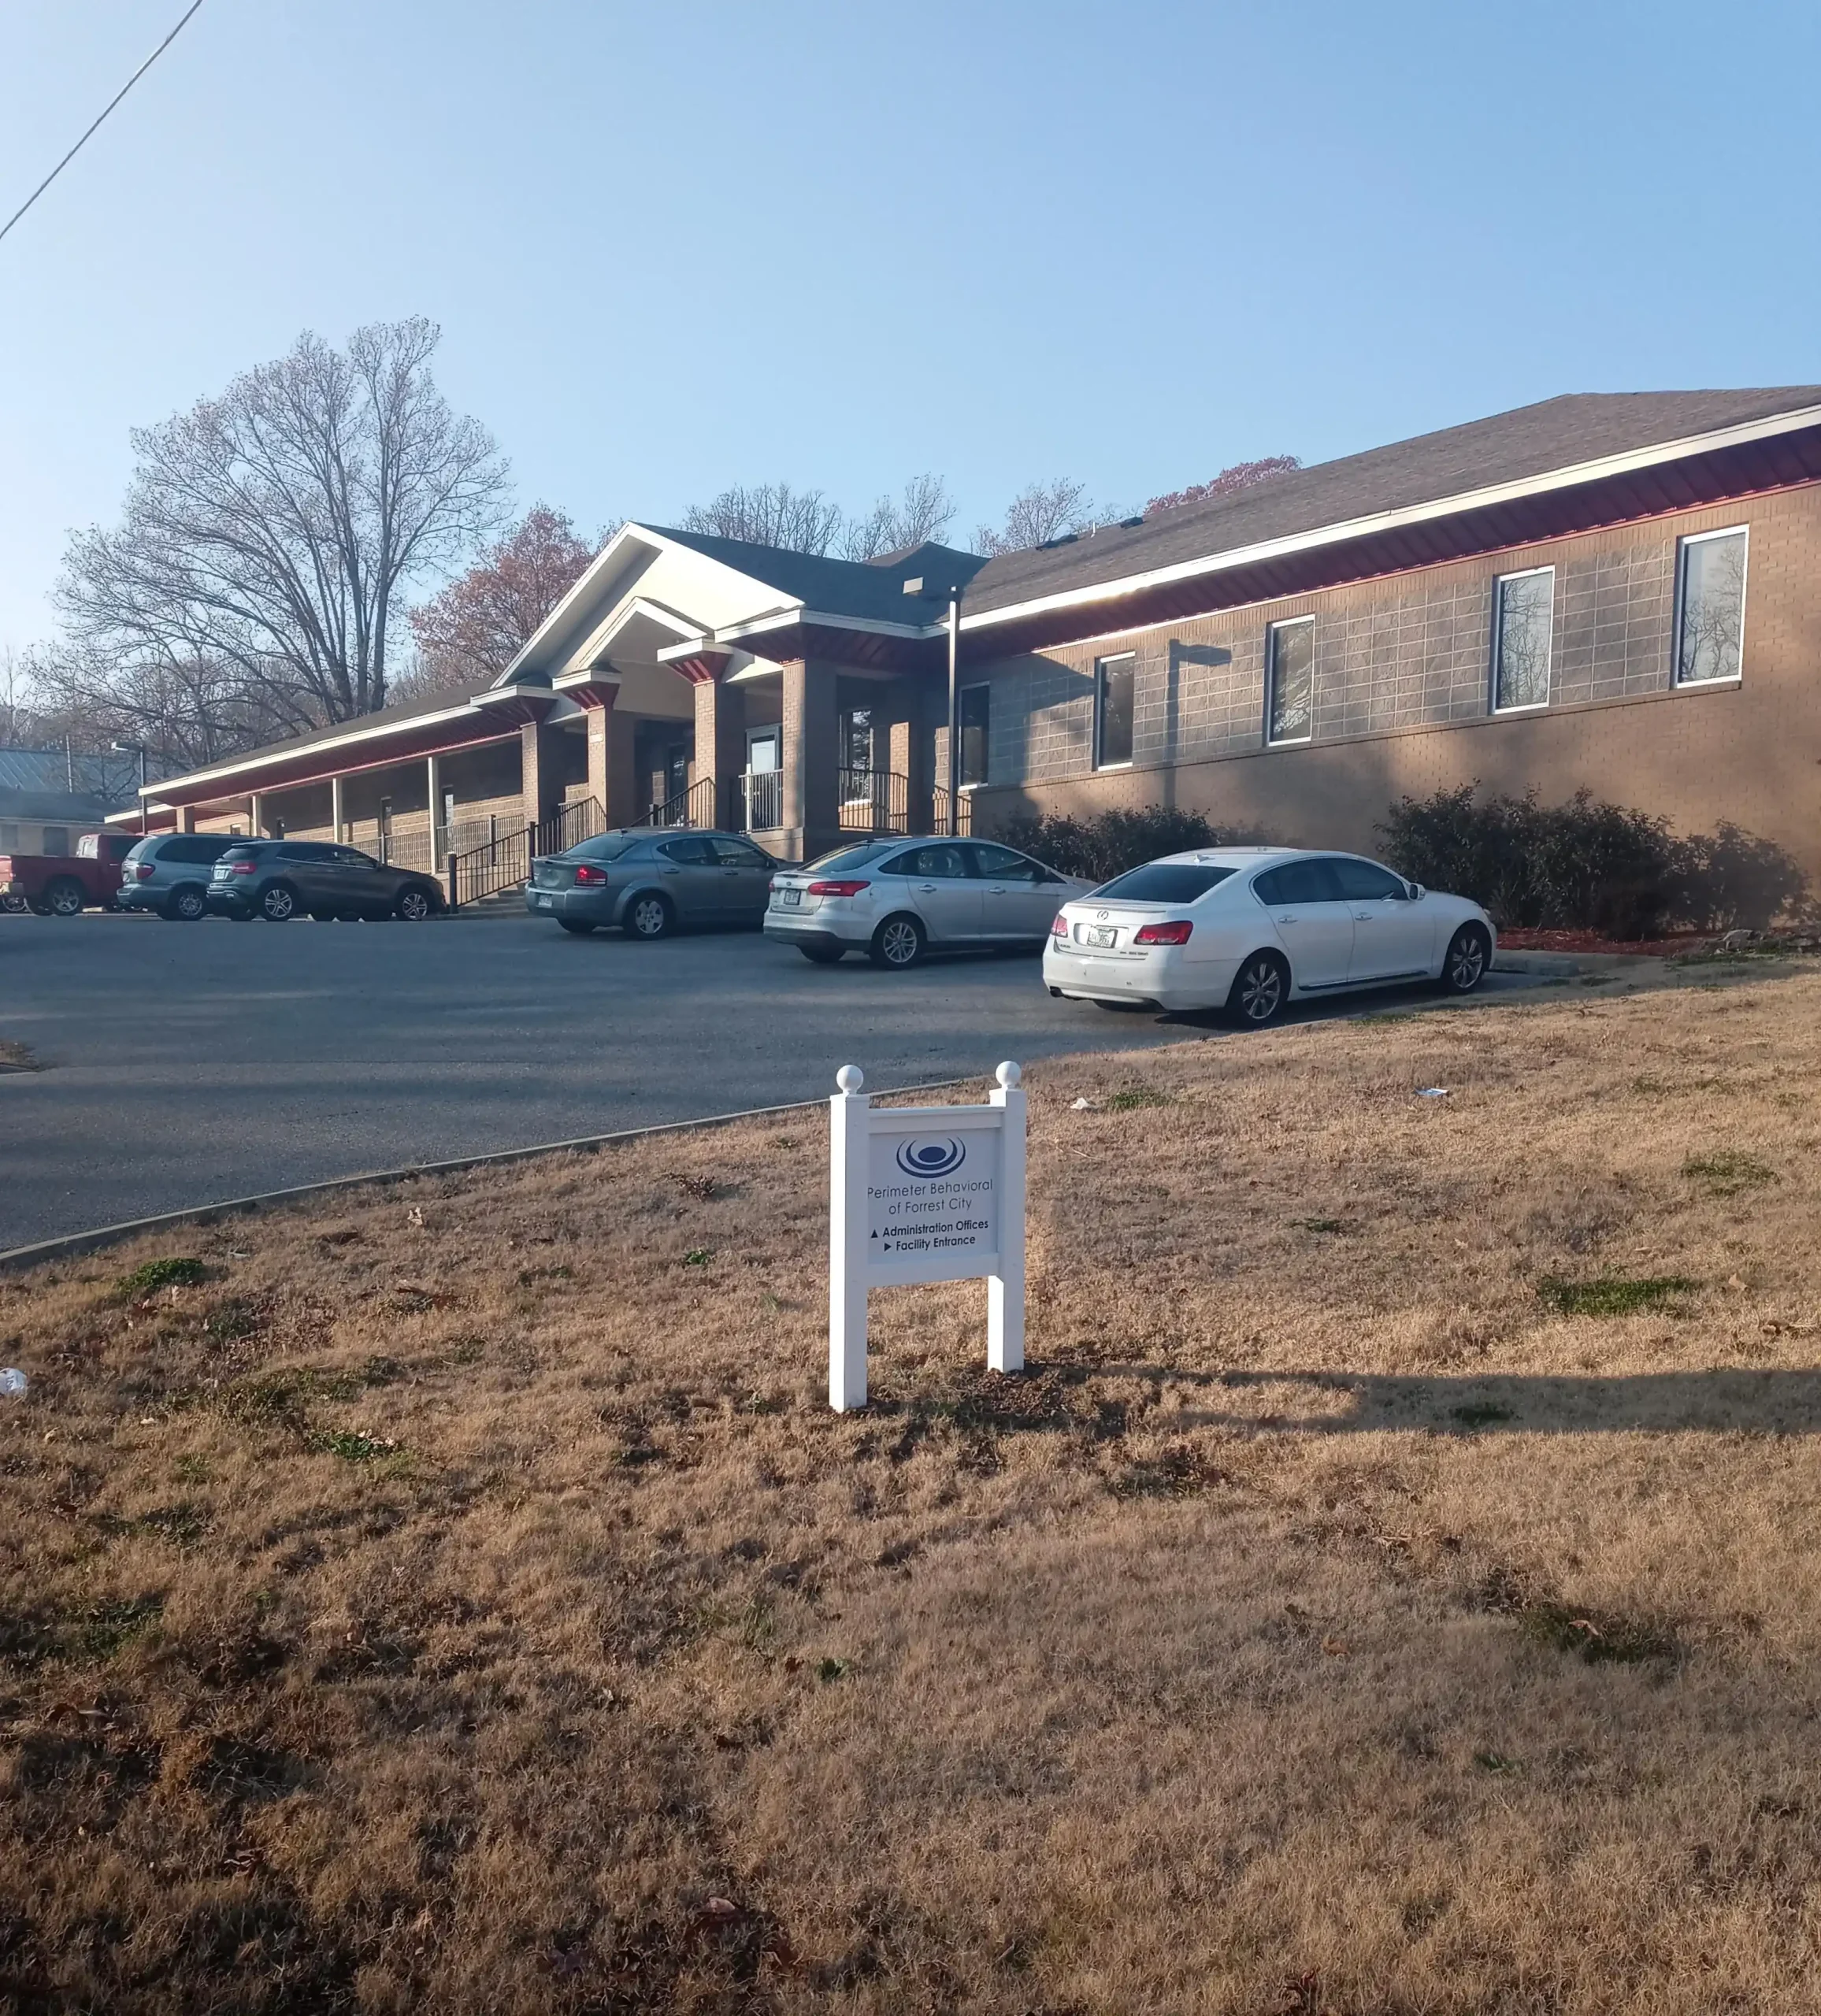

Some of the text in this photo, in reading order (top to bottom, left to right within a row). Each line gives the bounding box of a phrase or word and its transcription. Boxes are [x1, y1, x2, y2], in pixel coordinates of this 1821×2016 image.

[867, 1179, 993, 1199] Perimeter Behavioral
[888, 1198, 972, 1215] of Forrest City
[882, 1219, 989, 1238] Administration Offices
[896, 1236, 976, 1251] Facility Entrance
